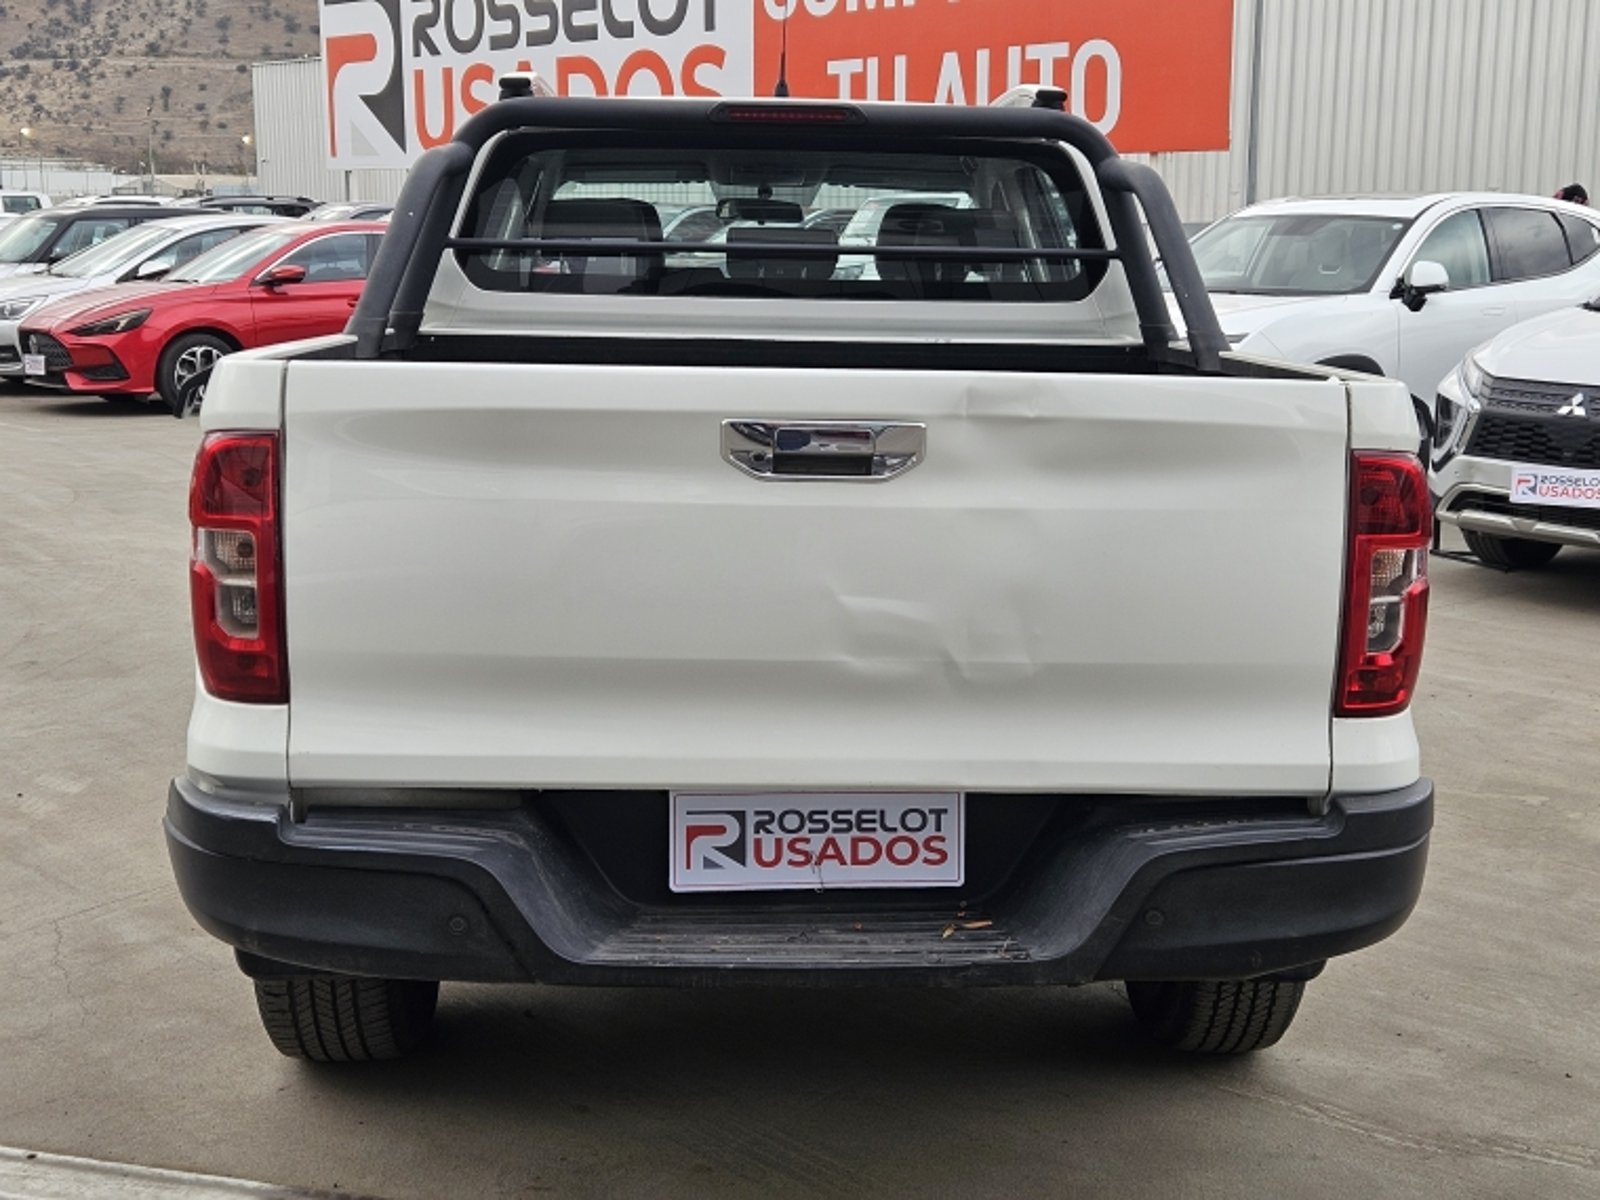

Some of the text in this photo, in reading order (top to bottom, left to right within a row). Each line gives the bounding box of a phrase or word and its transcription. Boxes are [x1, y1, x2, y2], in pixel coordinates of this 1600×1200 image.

[414, 44, 727, 150] USDOS
[753, 808, 948, 834] ROSSELOT
[753, 835, 948, 868] USADOS
